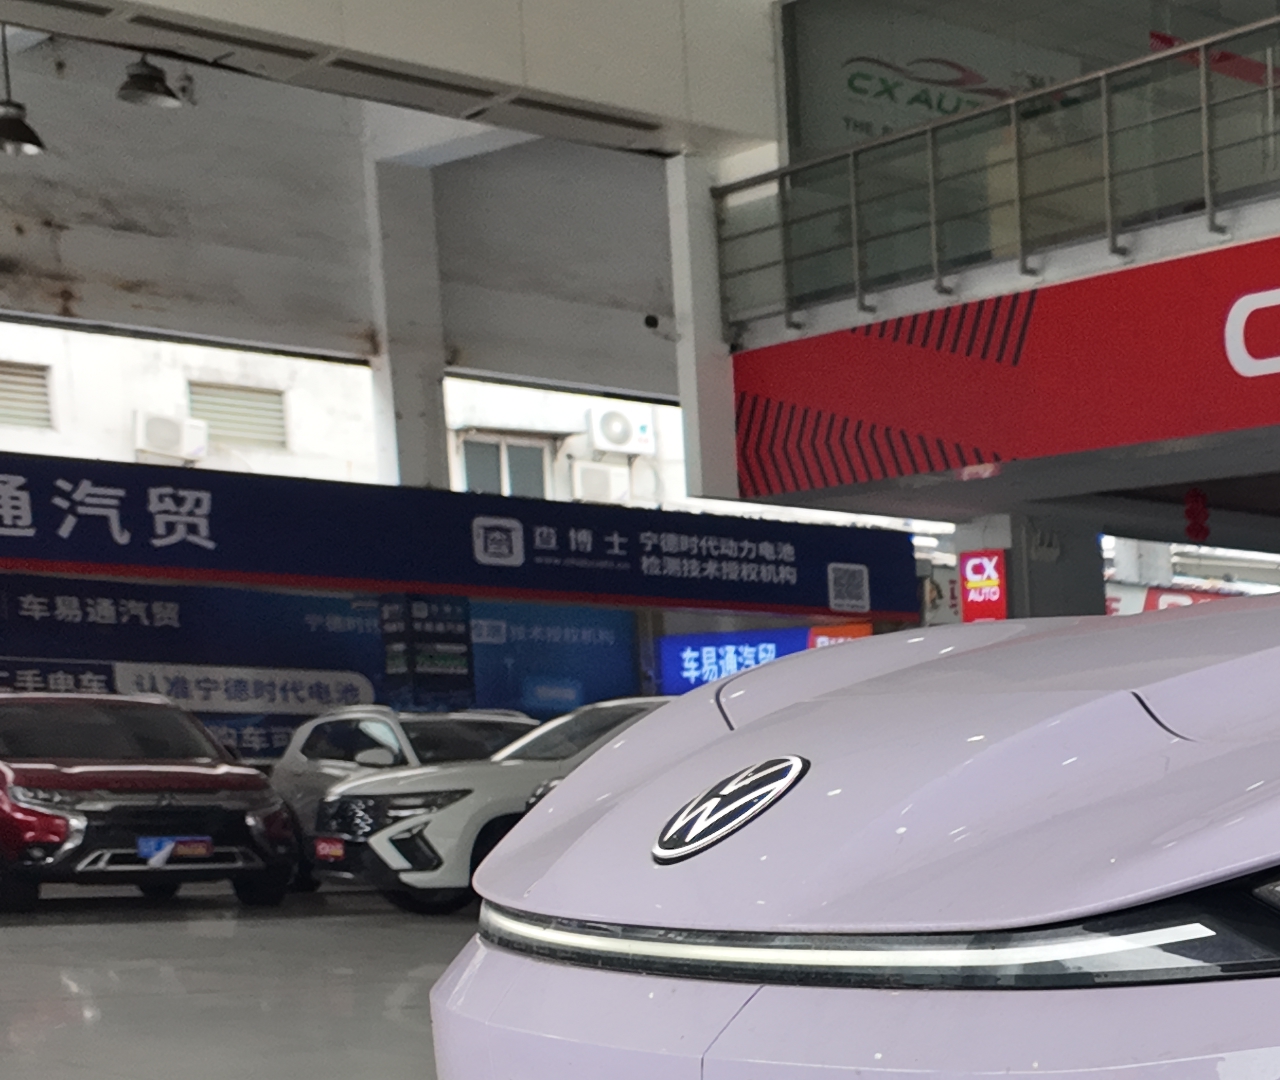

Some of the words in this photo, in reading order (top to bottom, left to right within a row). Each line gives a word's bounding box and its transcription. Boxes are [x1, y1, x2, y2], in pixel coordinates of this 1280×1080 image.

[847, 71, 902, 100] CX
[965, 556, 998, 581] CX
[967, 586, 1000, 602] AUTO
[18, 594, 181, 628] 车易通汽贸
[680, 643, 776, 684] 车易通汽贸
[0, 668, 109, 692] 手电车
